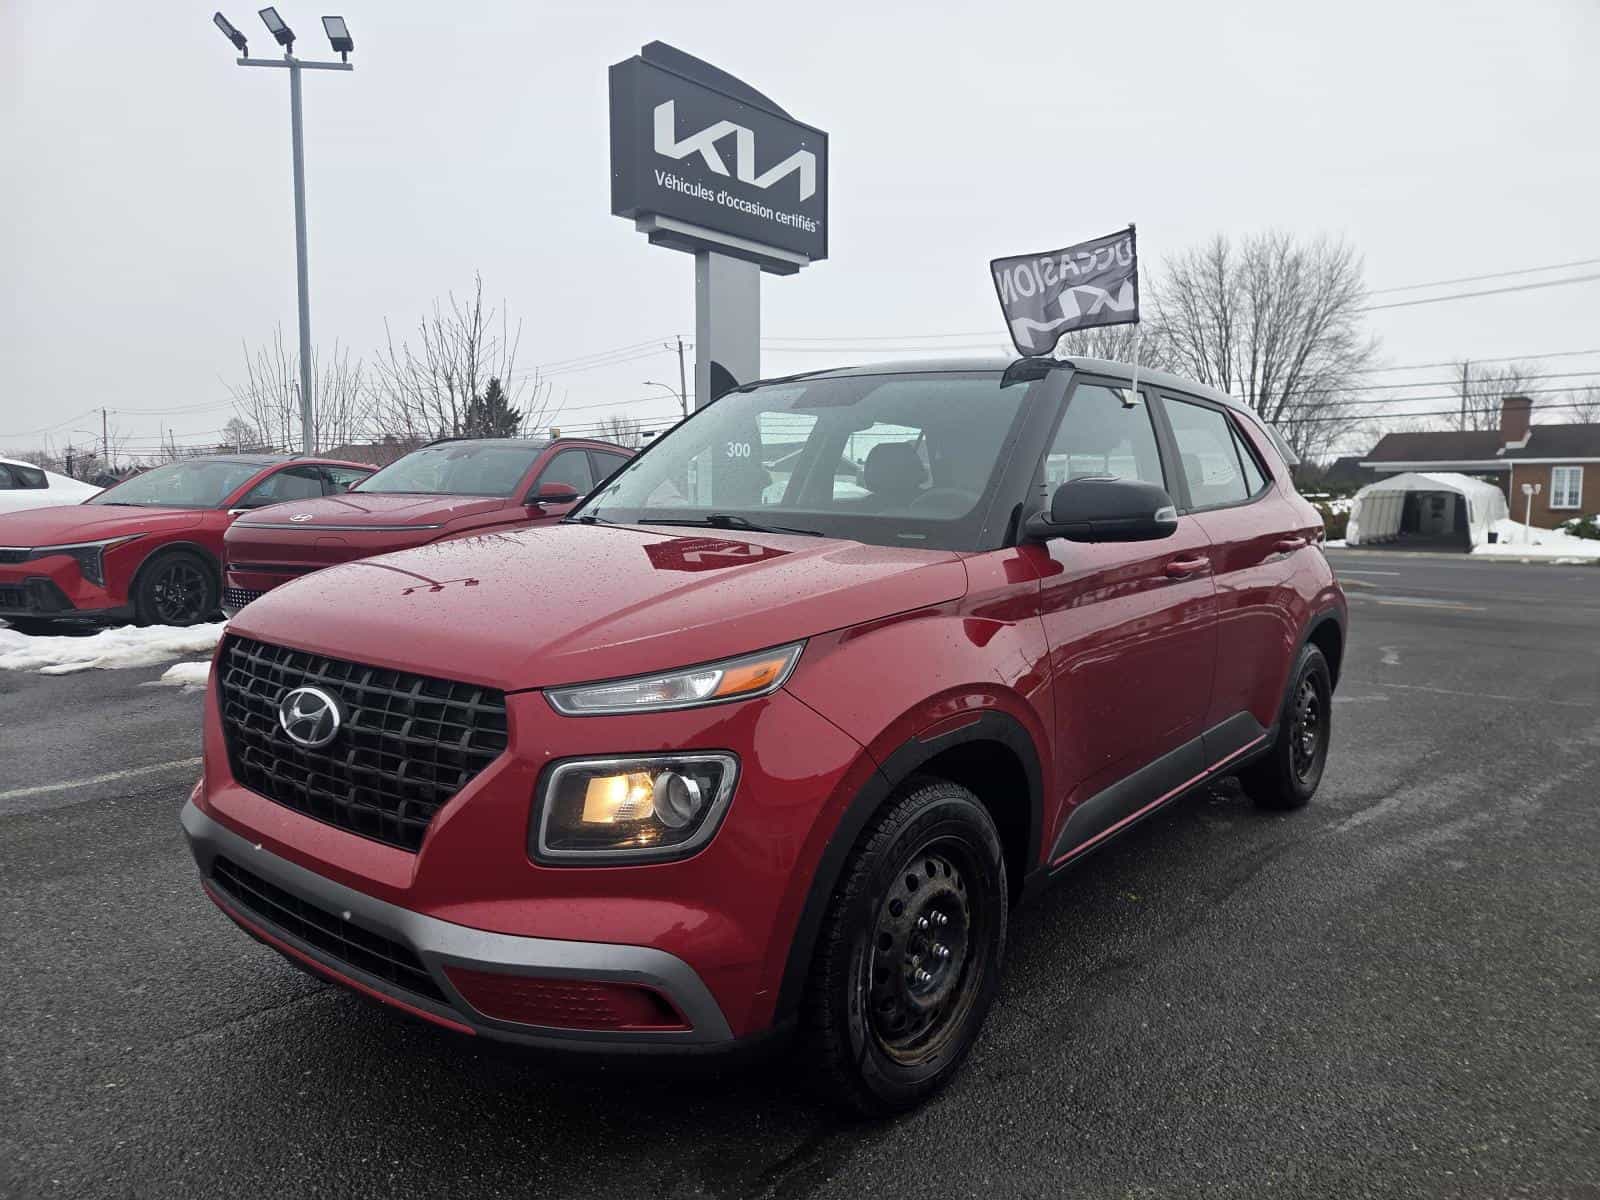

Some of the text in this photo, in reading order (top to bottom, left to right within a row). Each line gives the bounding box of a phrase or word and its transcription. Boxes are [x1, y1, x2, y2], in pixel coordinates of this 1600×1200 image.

[653, 99, 816, 203] KIA
[654, 169, 714, 202] Véhicules
[717, 189, 774, 221] d'occasion
[727, 441, 751, 458] 300
